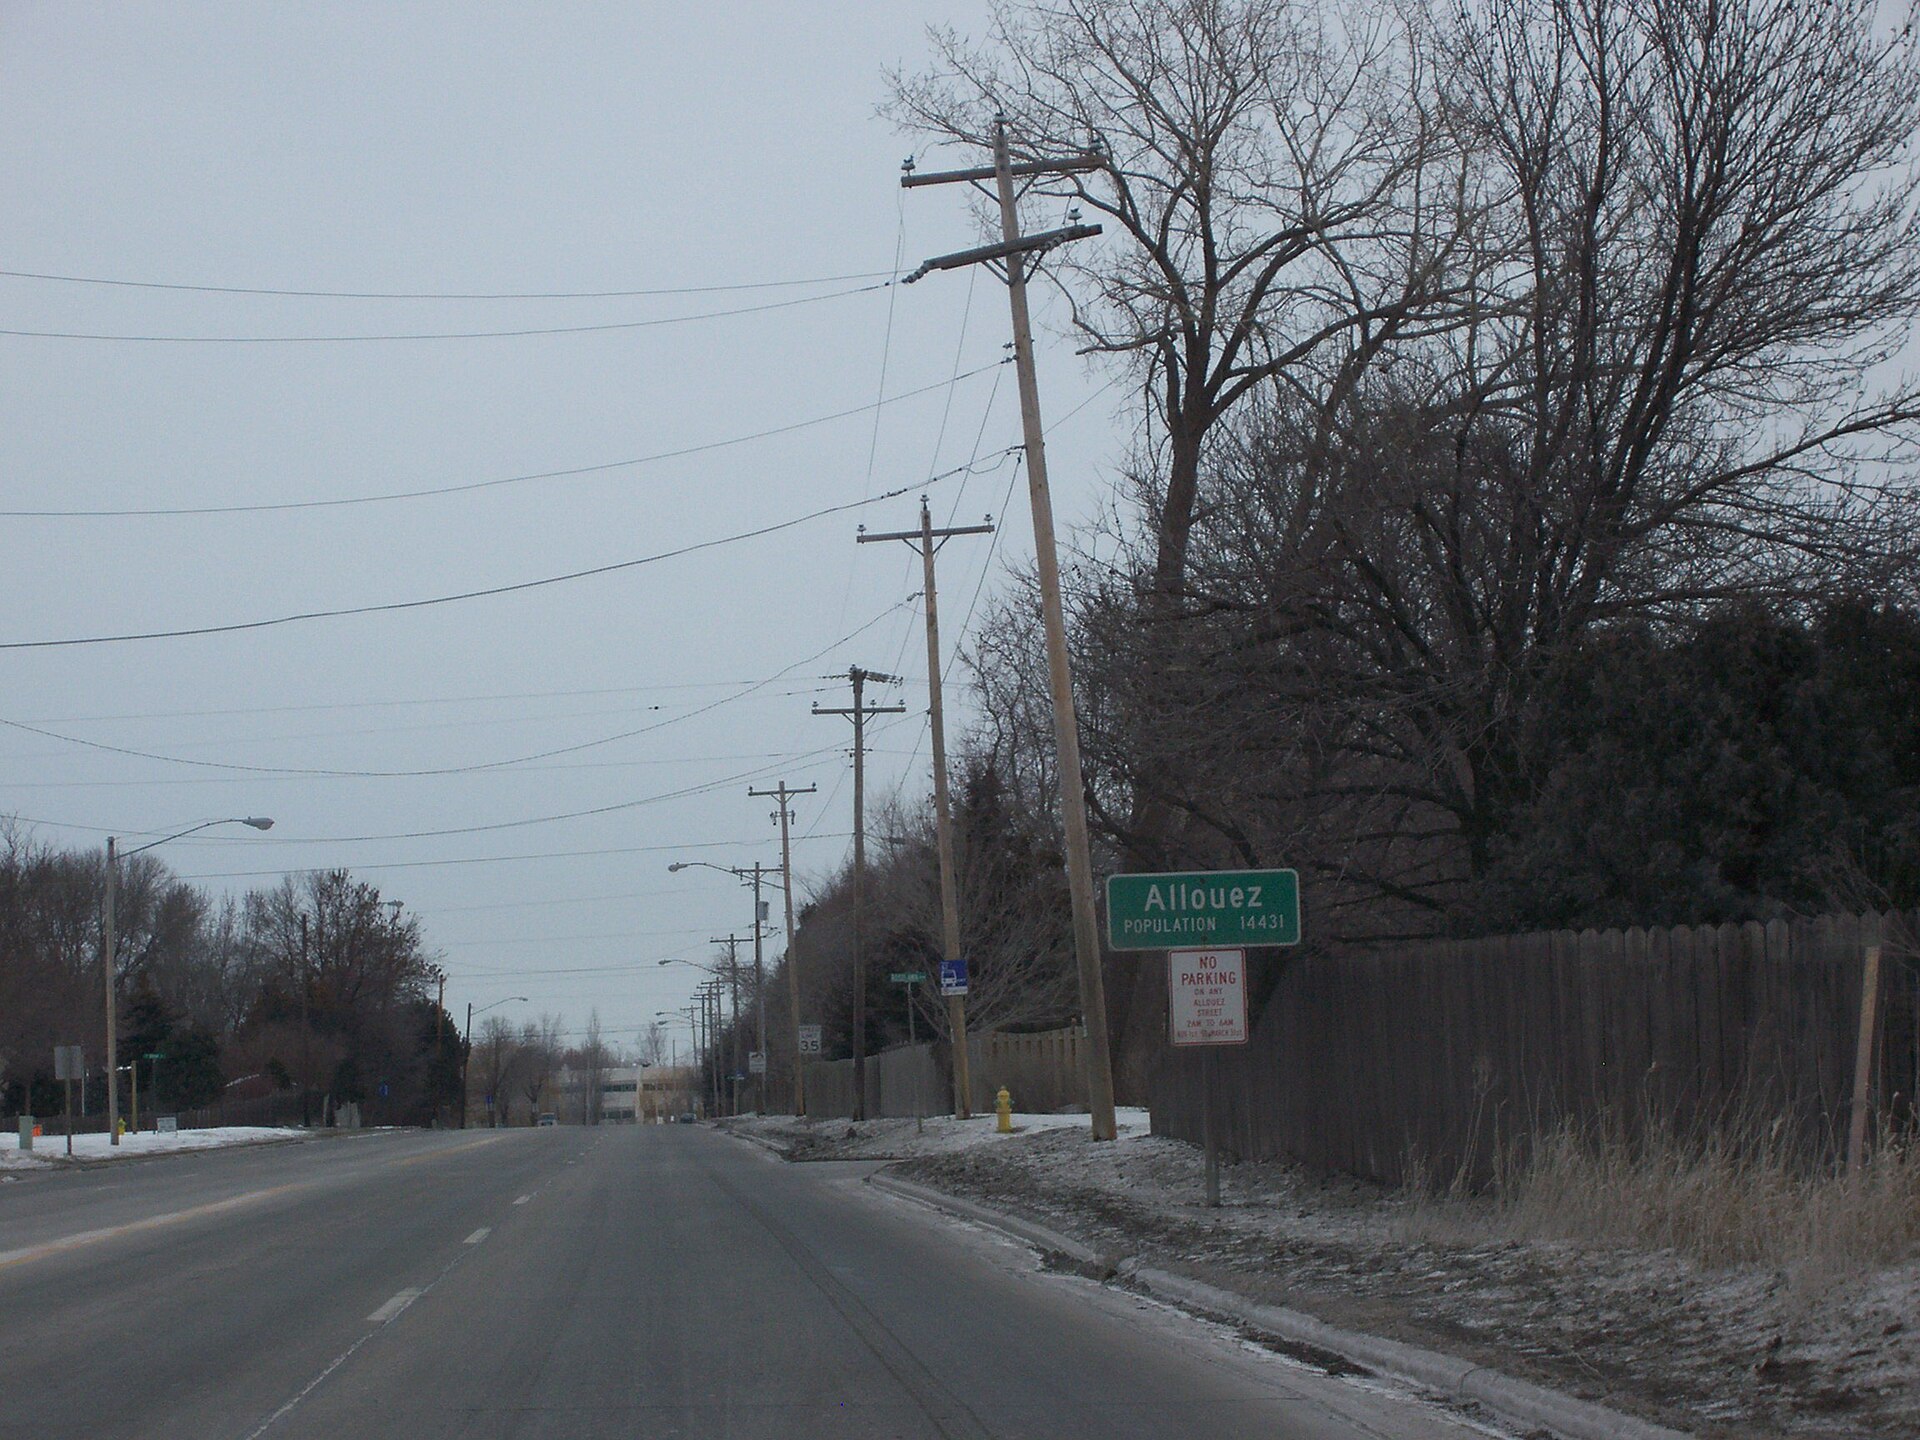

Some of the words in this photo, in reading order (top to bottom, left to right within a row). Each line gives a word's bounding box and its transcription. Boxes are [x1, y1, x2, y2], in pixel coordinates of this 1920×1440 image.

[1144, 884, 1263, 911] Allouez
[1124, 917, 1216, 933] POPULATION
[1240, 914, 1284, 930] 14431
[1199, 956, 1217, 969] NO
[1181, 972, 1236, 986] PARKING
[1209, 987, 1223, 995] ANY
[1193, 998, 1225, 1007] ALLOUEZ
[800, 1040, 819, 1052] 35
